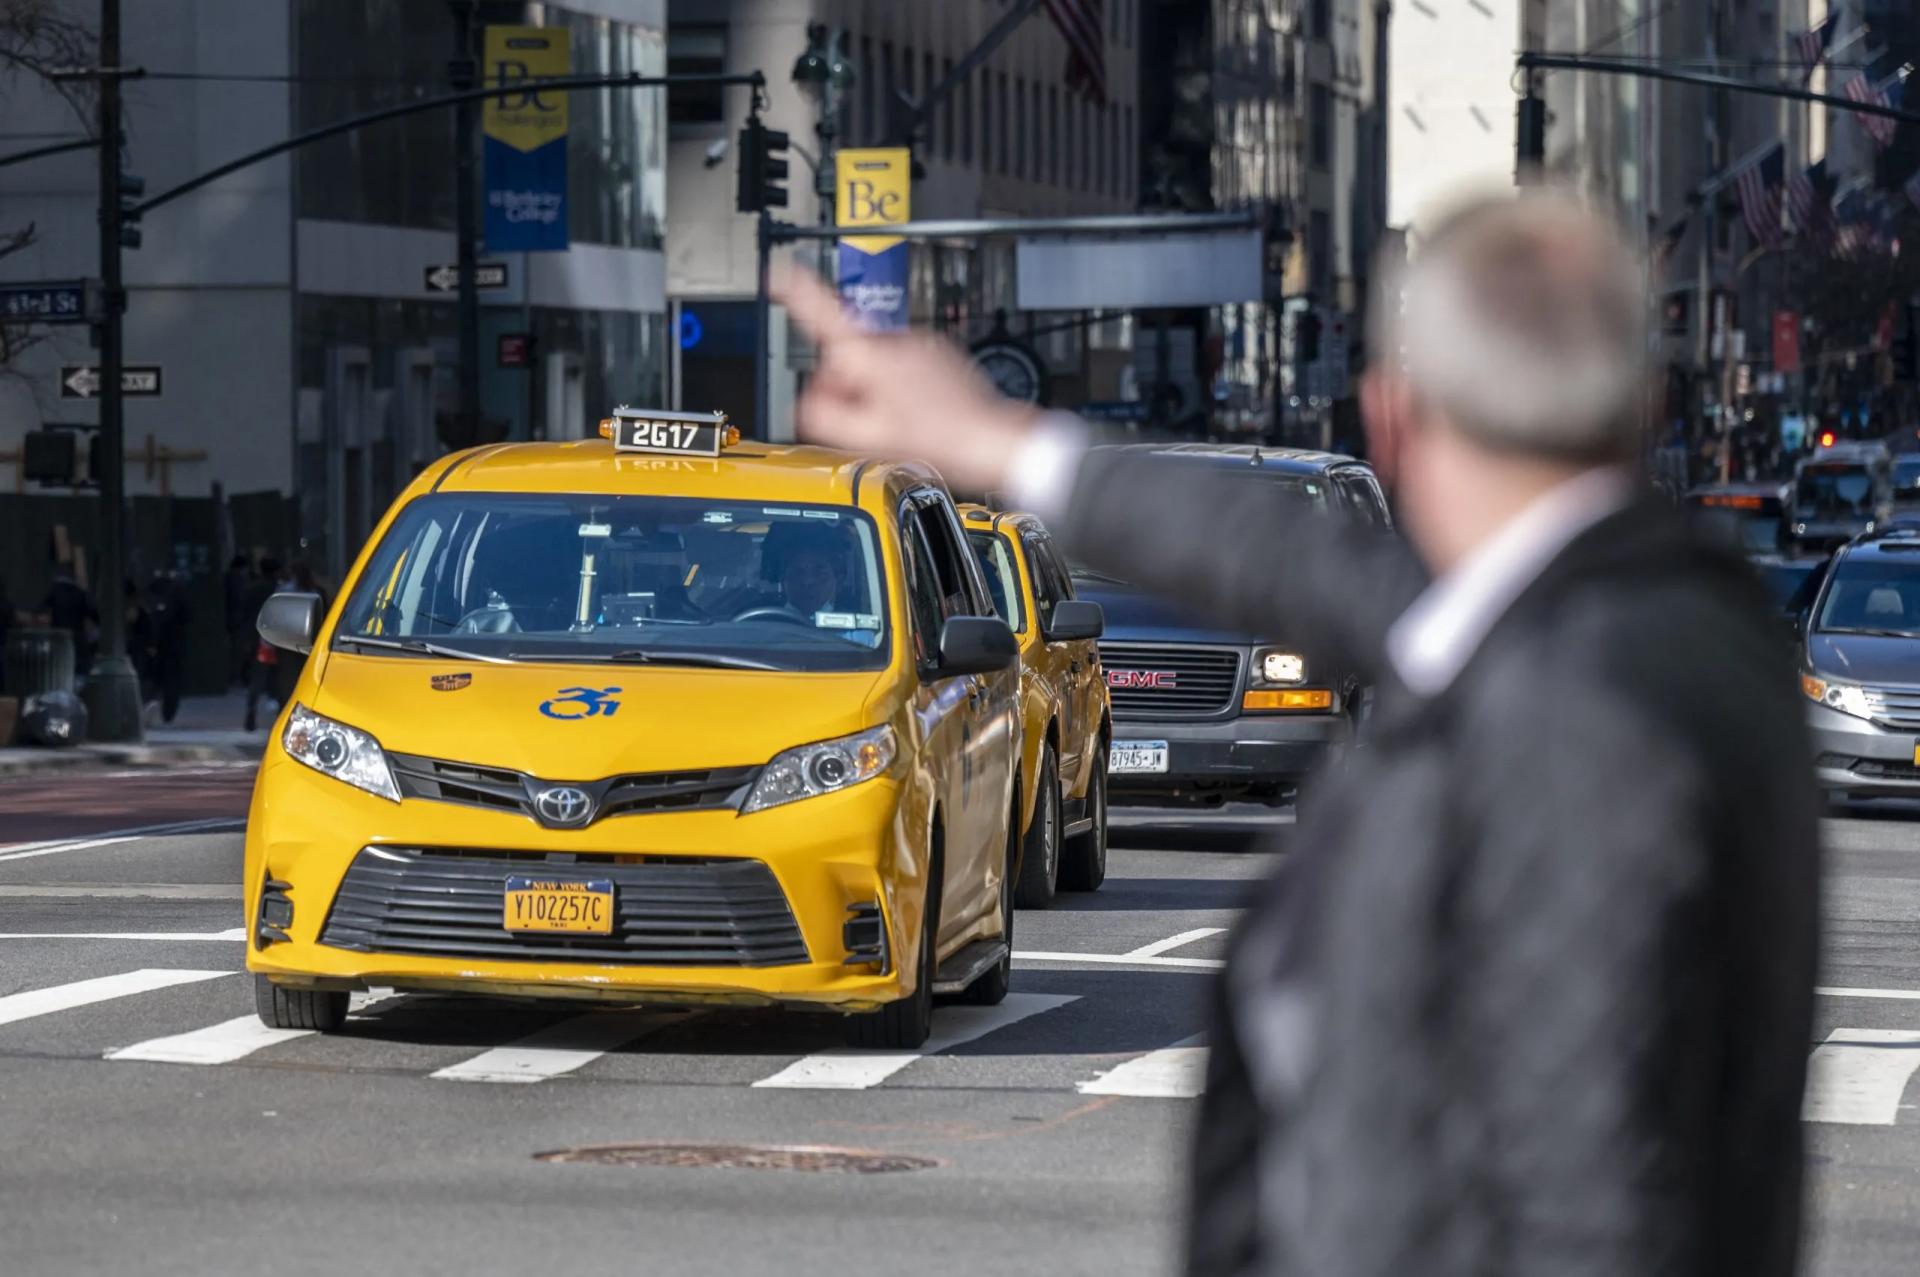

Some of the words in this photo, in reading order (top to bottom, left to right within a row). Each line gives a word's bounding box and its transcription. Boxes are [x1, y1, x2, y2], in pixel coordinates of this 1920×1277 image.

[847, 181, 899, 221] Be
[56, 291, 77, 313] St
[632, 420, 699, 449] 2G17
[1107, 670, 1176, 688] GMC
[531, 881, 557, 891] NEW
[558, 882, 588, 893] YORK
[515, 894, 602, 922] Y102257C
